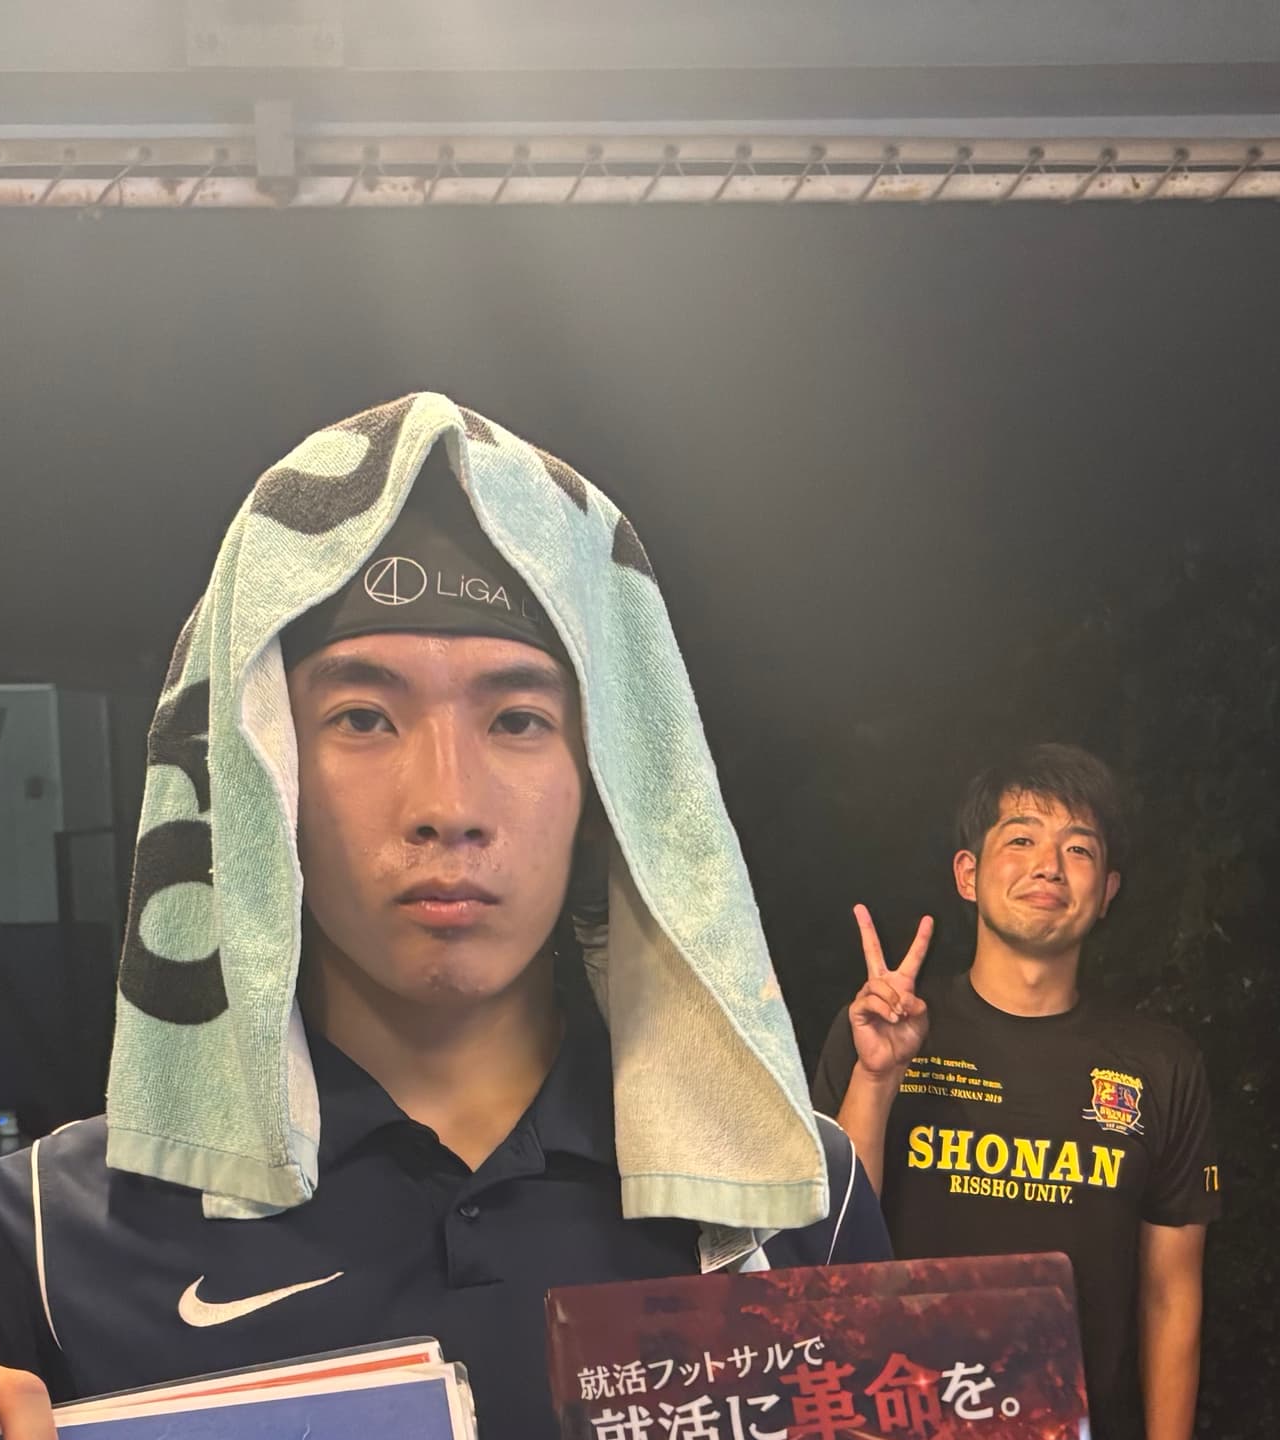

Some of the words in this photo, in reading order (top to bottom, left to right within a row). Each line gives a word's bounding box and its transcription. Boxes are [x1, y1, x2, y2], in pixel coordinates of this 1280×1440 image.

[436, 575, 512, 610] LiGA
[907, 1125, 1126, 1189] SHONAN
[949, 1174, 1019, 1200] RISSHO
[1023, 1182, 1074, 1205] UNIV.
[577, 1336, 826, 1402] 就活フットサルで
